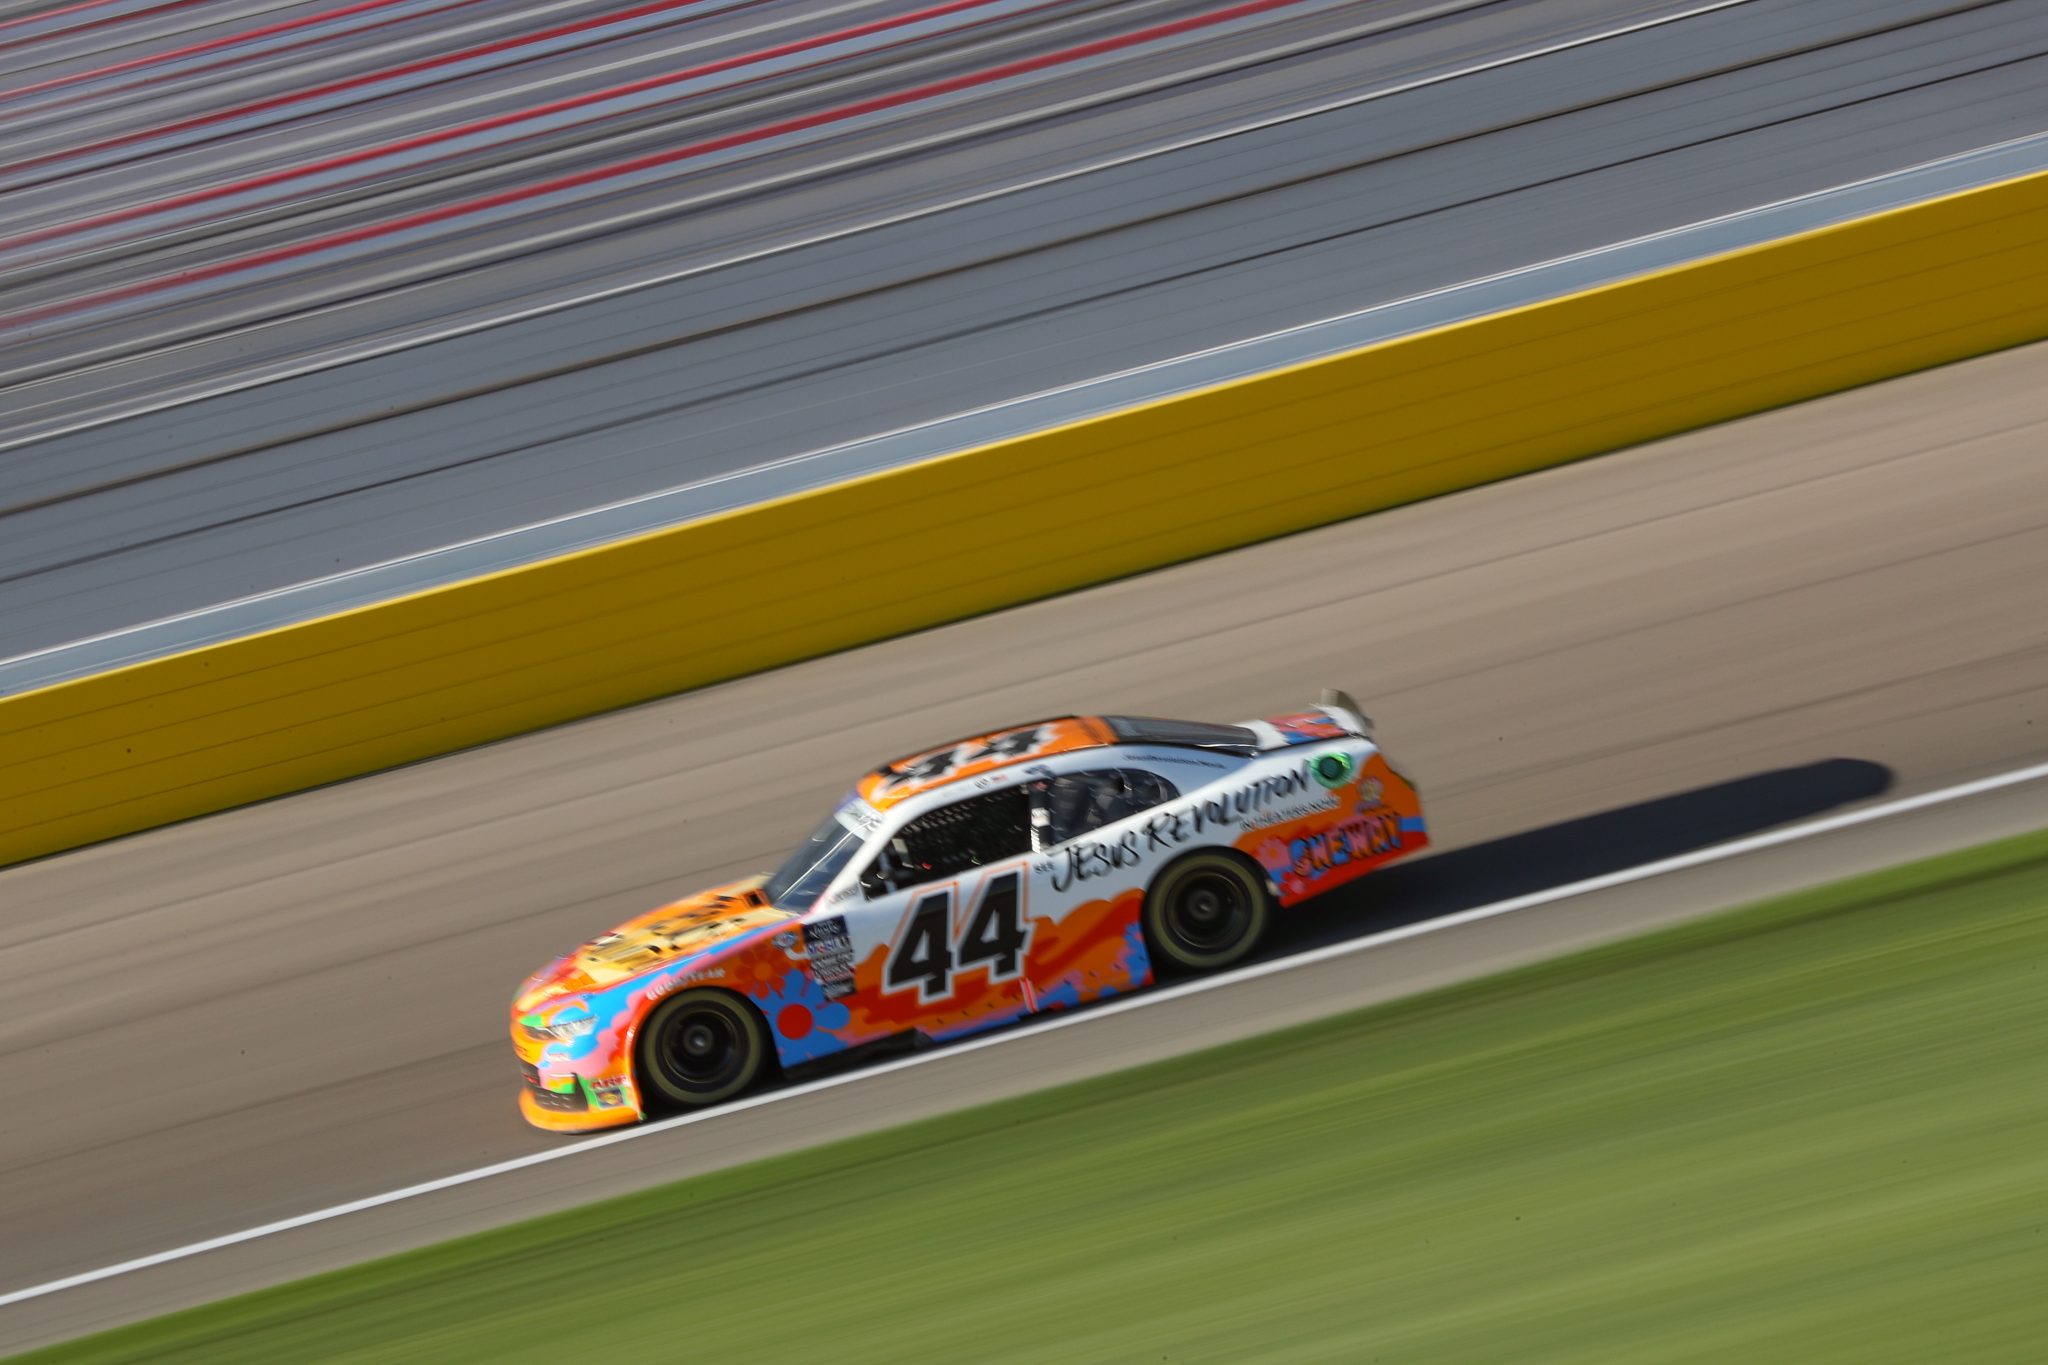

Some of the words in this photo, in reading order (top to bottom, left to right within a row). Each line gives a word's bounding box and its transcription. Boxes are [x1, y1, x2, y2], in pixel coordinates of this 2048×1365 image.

[1051, 830, 1142, 894] JESUS
[1141, 760, 1310, 852] REVOLUTION
[884, 866, 1032, 1000] 44
